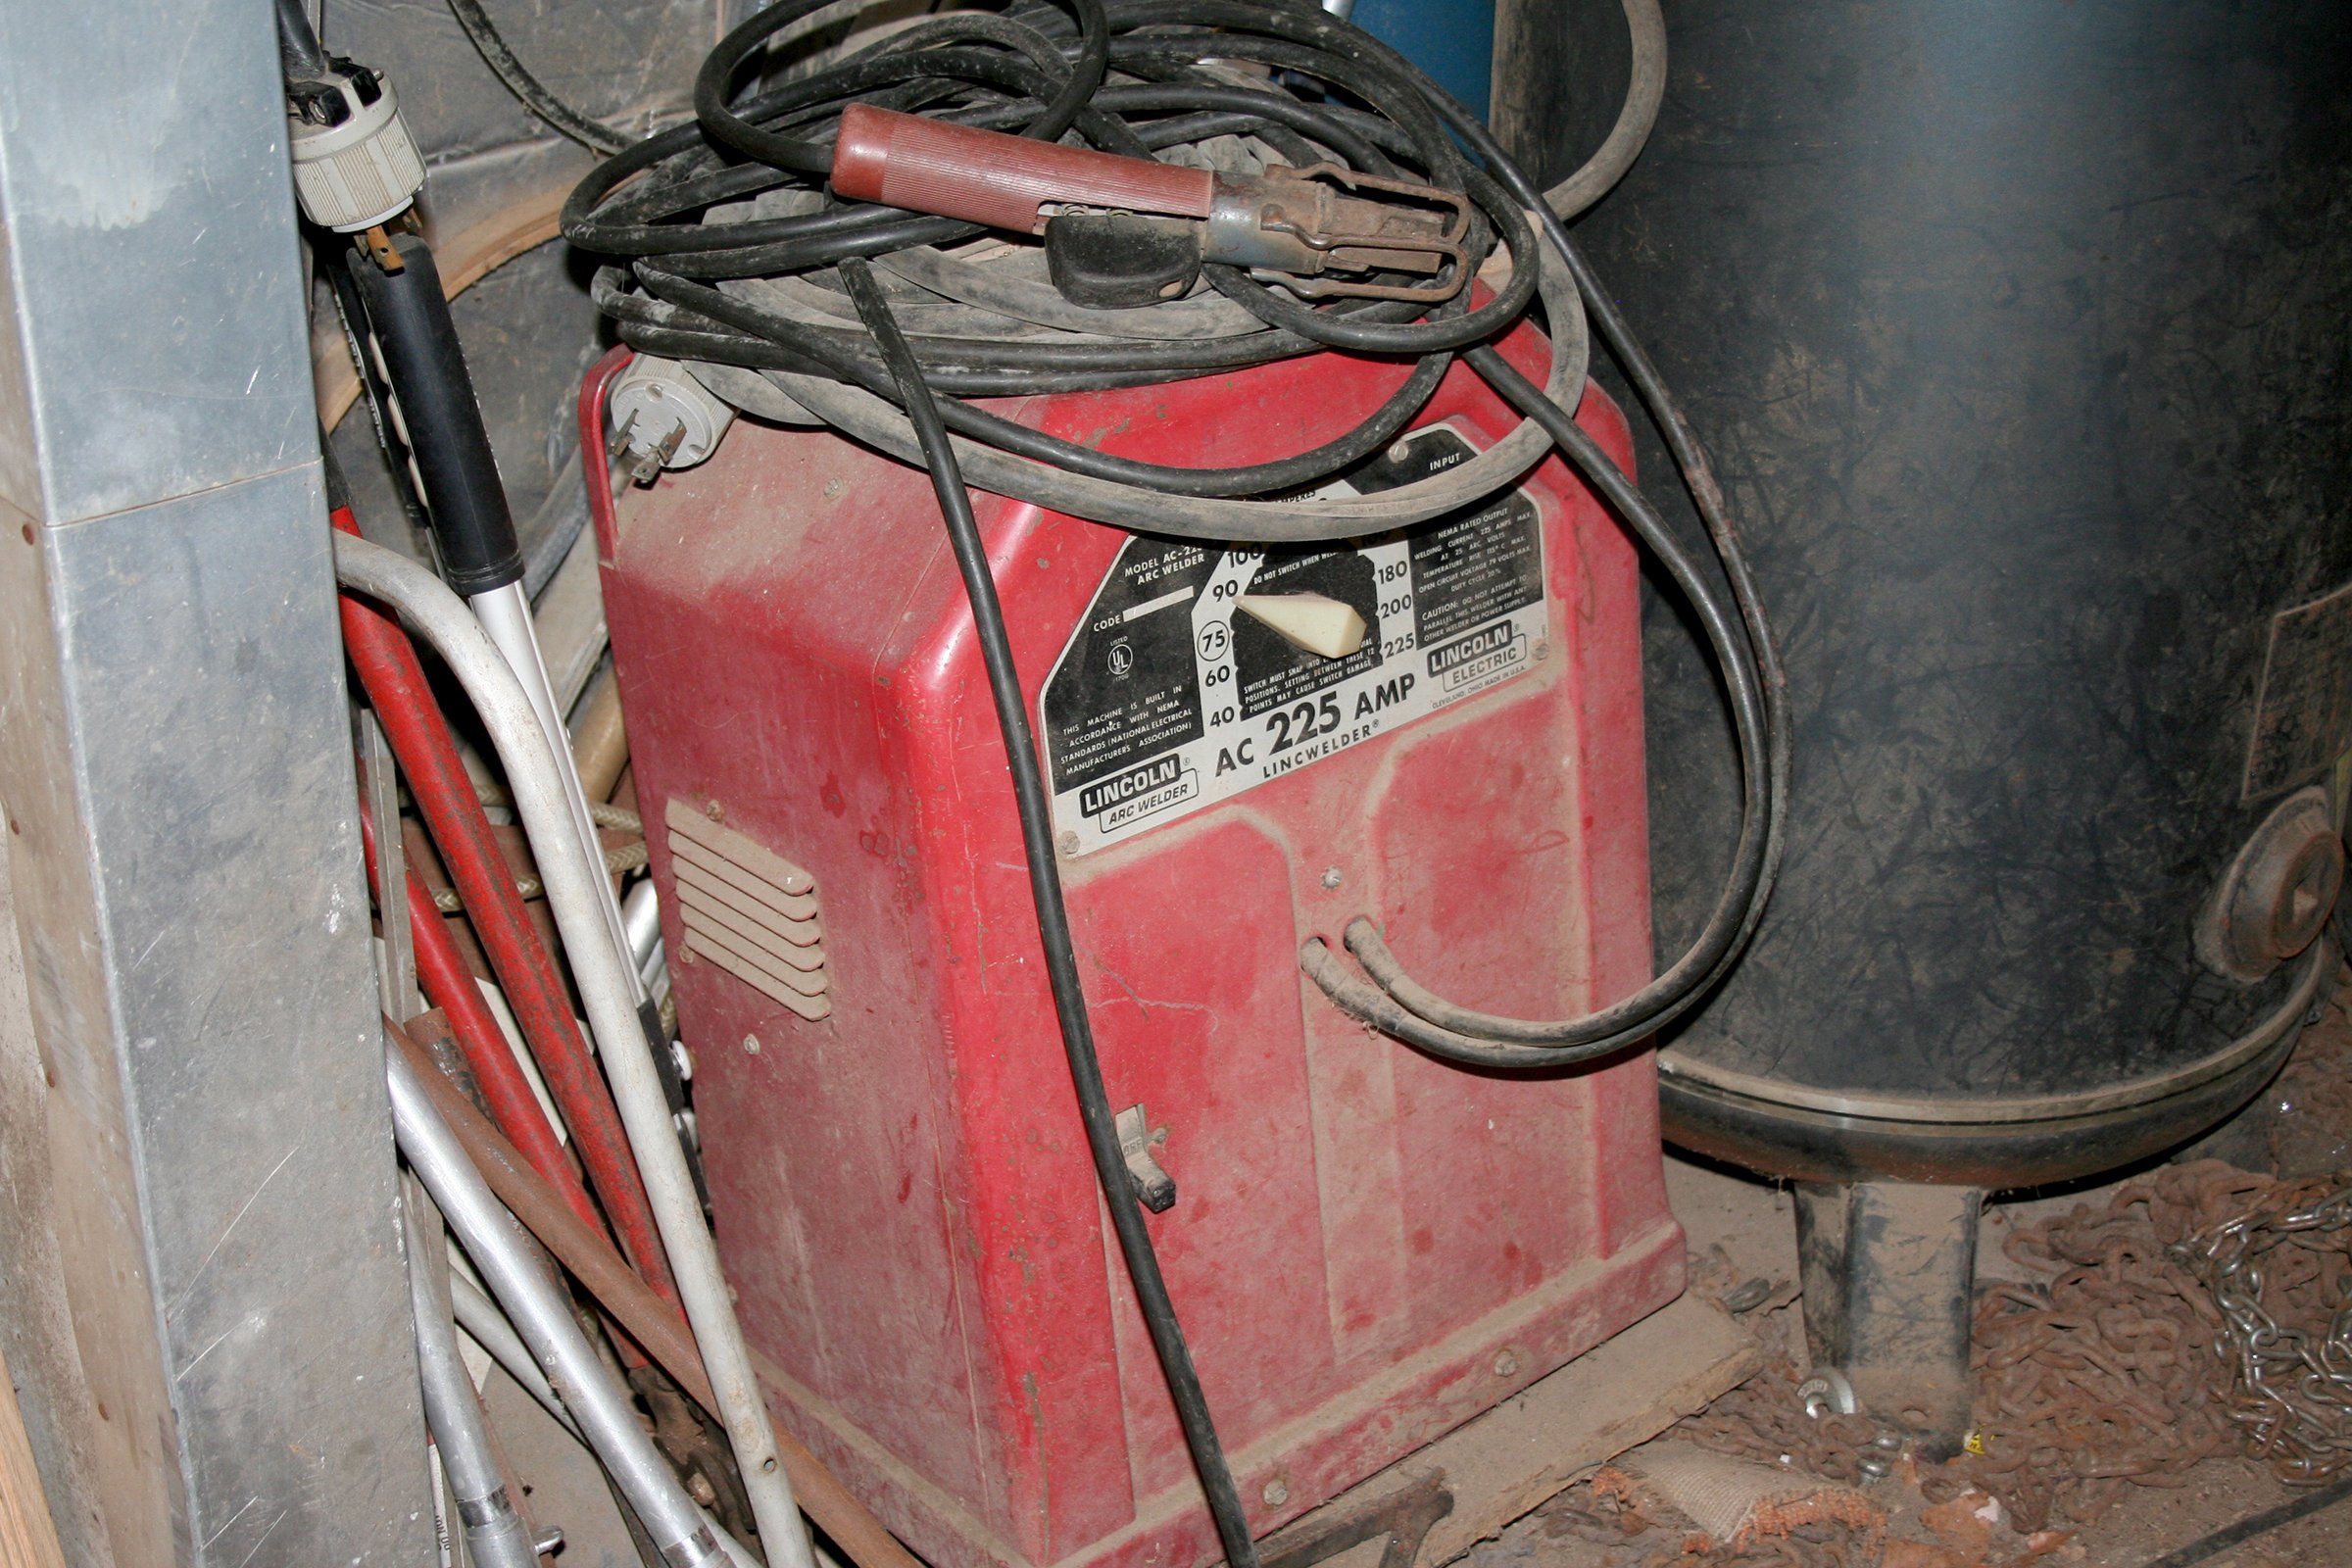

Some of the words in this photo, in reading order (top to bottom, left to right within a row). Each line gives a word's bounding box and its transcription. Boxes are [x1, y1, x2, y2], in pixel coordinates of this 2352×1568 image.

[1430, 453, 1460, 470] INPUT
[1438, 527, 1458, 539] NEMA
[1460, 517, 1481, 530] RATED
[1483, 508, 1507, 522] OUTPUT
[1227, 542, 1262, 568] 100
[1414, 545, 1442, 560] WELDING
[1447, 533, 1474, 547] CURRENT
[1495, 519, 1511, 530] AMPS
[1469, 541, 1482, 550] ARC
[1487, 532, 1505, 543] VOLTS
[1124, 558, 1159, 577] MODEL
[1137, 569, 1159, 586] ARC
[1161, 553, 1205, 575] WELDER
[1253, 575, 1262, 585] DO
[1264, 570, 1276, 581] NOT
[1278, 560, 1300, 576] SWITCH
[1302, 555, 1320, 567] WHEN
[1378, 560, 1407, 585] 180
[1418, 582, 1435, 593] OPEN
[1437, 573, 1458, 586] CIRCUIT
[1460, 563, 1487, 577] VOLTAGE
[1497, 550, 1515, 563] VOLTS
[1423, 559, 1463, 578] TEMPERATURE
[1469, 552, 1481, 562] RISE
[1212, 579, 1239, 603] 90
[1450, 582, 1466, 592] DUTY
[1468, 573, 1486, 585] CYCLE
[1381, 594, 1411, 619] 200
[1422, 601, 1459, 621] CAUTION:
[1462, 597, 1472, 606] DO
[1475, 590, 1488, 600] NOT
[1491, 579, 1516, 594] ATTEMPT
[1423, 615, 1453, 631] PARALLEL
[1471, 598, 1494, 612] WELDER
[1496, 592, 1512, 603] WITH
[1514, 586, 1527, 596] ANY
[1093, 614, 1121, 633] CODE
[1424, 629, 1445, 642] OTHER
[1446, 619, 1469, 633] WELDER
[1471, 614, 1480, 623] OR
[1481, 606, 1503, 618] POWER
[1109, 636, 1128, 647] LISTED
[1202, 629, 1226, 654] 75
[1384, 633, 1415, 661] 225
[1431, 625, 1508, 672] LINCOLN
[1112, 650, 1128, 669] UL
[1284, 671, 1310, 690] SETTING
[1313, 660, 1342, 677] BETWEEN
[1346, 652, 1364, 664] THESE
[1367, 647, 1375, 657] 12
[1452, 648, 1517, 685] ELECTRIC
[1204, 664, 1230, 687] 60
[1244, 679, 1266, 694] SWITCH
[1269, 671, 1285, 684] MUST
[1288, 664, 1302, 677] SNAP
[1305, 658, 1320, 669] INTO
[1485, 675, 1501, 687] MADE
[1249, 699, 1273, 713] POINTS
[1276, 691, 1292, 703] MAY
[1296, 682, 1315, 696] CAUSE
[1319, 670, 1343, 686] SWITCH
[1063, 724, 1079, 736] THIS
[1087, 708, 1123, 727] MACHINE
[1130, 702, 1138, 710] IS
[1145, 691, 1165, 705] BUILT
[1173, 685, 1182, 695] IN
[1069, 721, 1121, 748] ACCORDANCE
[1129, 711, 1150, 724] WITH
[1156, 700, 1180, 713] NEMA
[1209, 706, 1235, 727] 40
[1215, 737, 1254, 777] AC
[1265, 690, 1342, 757] 225
[1354, 672, 1415, 721] AMP
[1060, 741, 1106, 764] STANDARDS
[1107, 725, 1151, 747] (NATIONAL
[1152, 709, 1193, 729] ELECTRICAL
[1065, 745, 1131, 776] MANUFACTURERS
[1138, 721, 1192, 748] ASSOCIATION)
[1084, 759, 1176, 813] LINCOLN
[1108, 805, 1135, 825] ARC
[1138, 783, 1188, 813] WELDER
